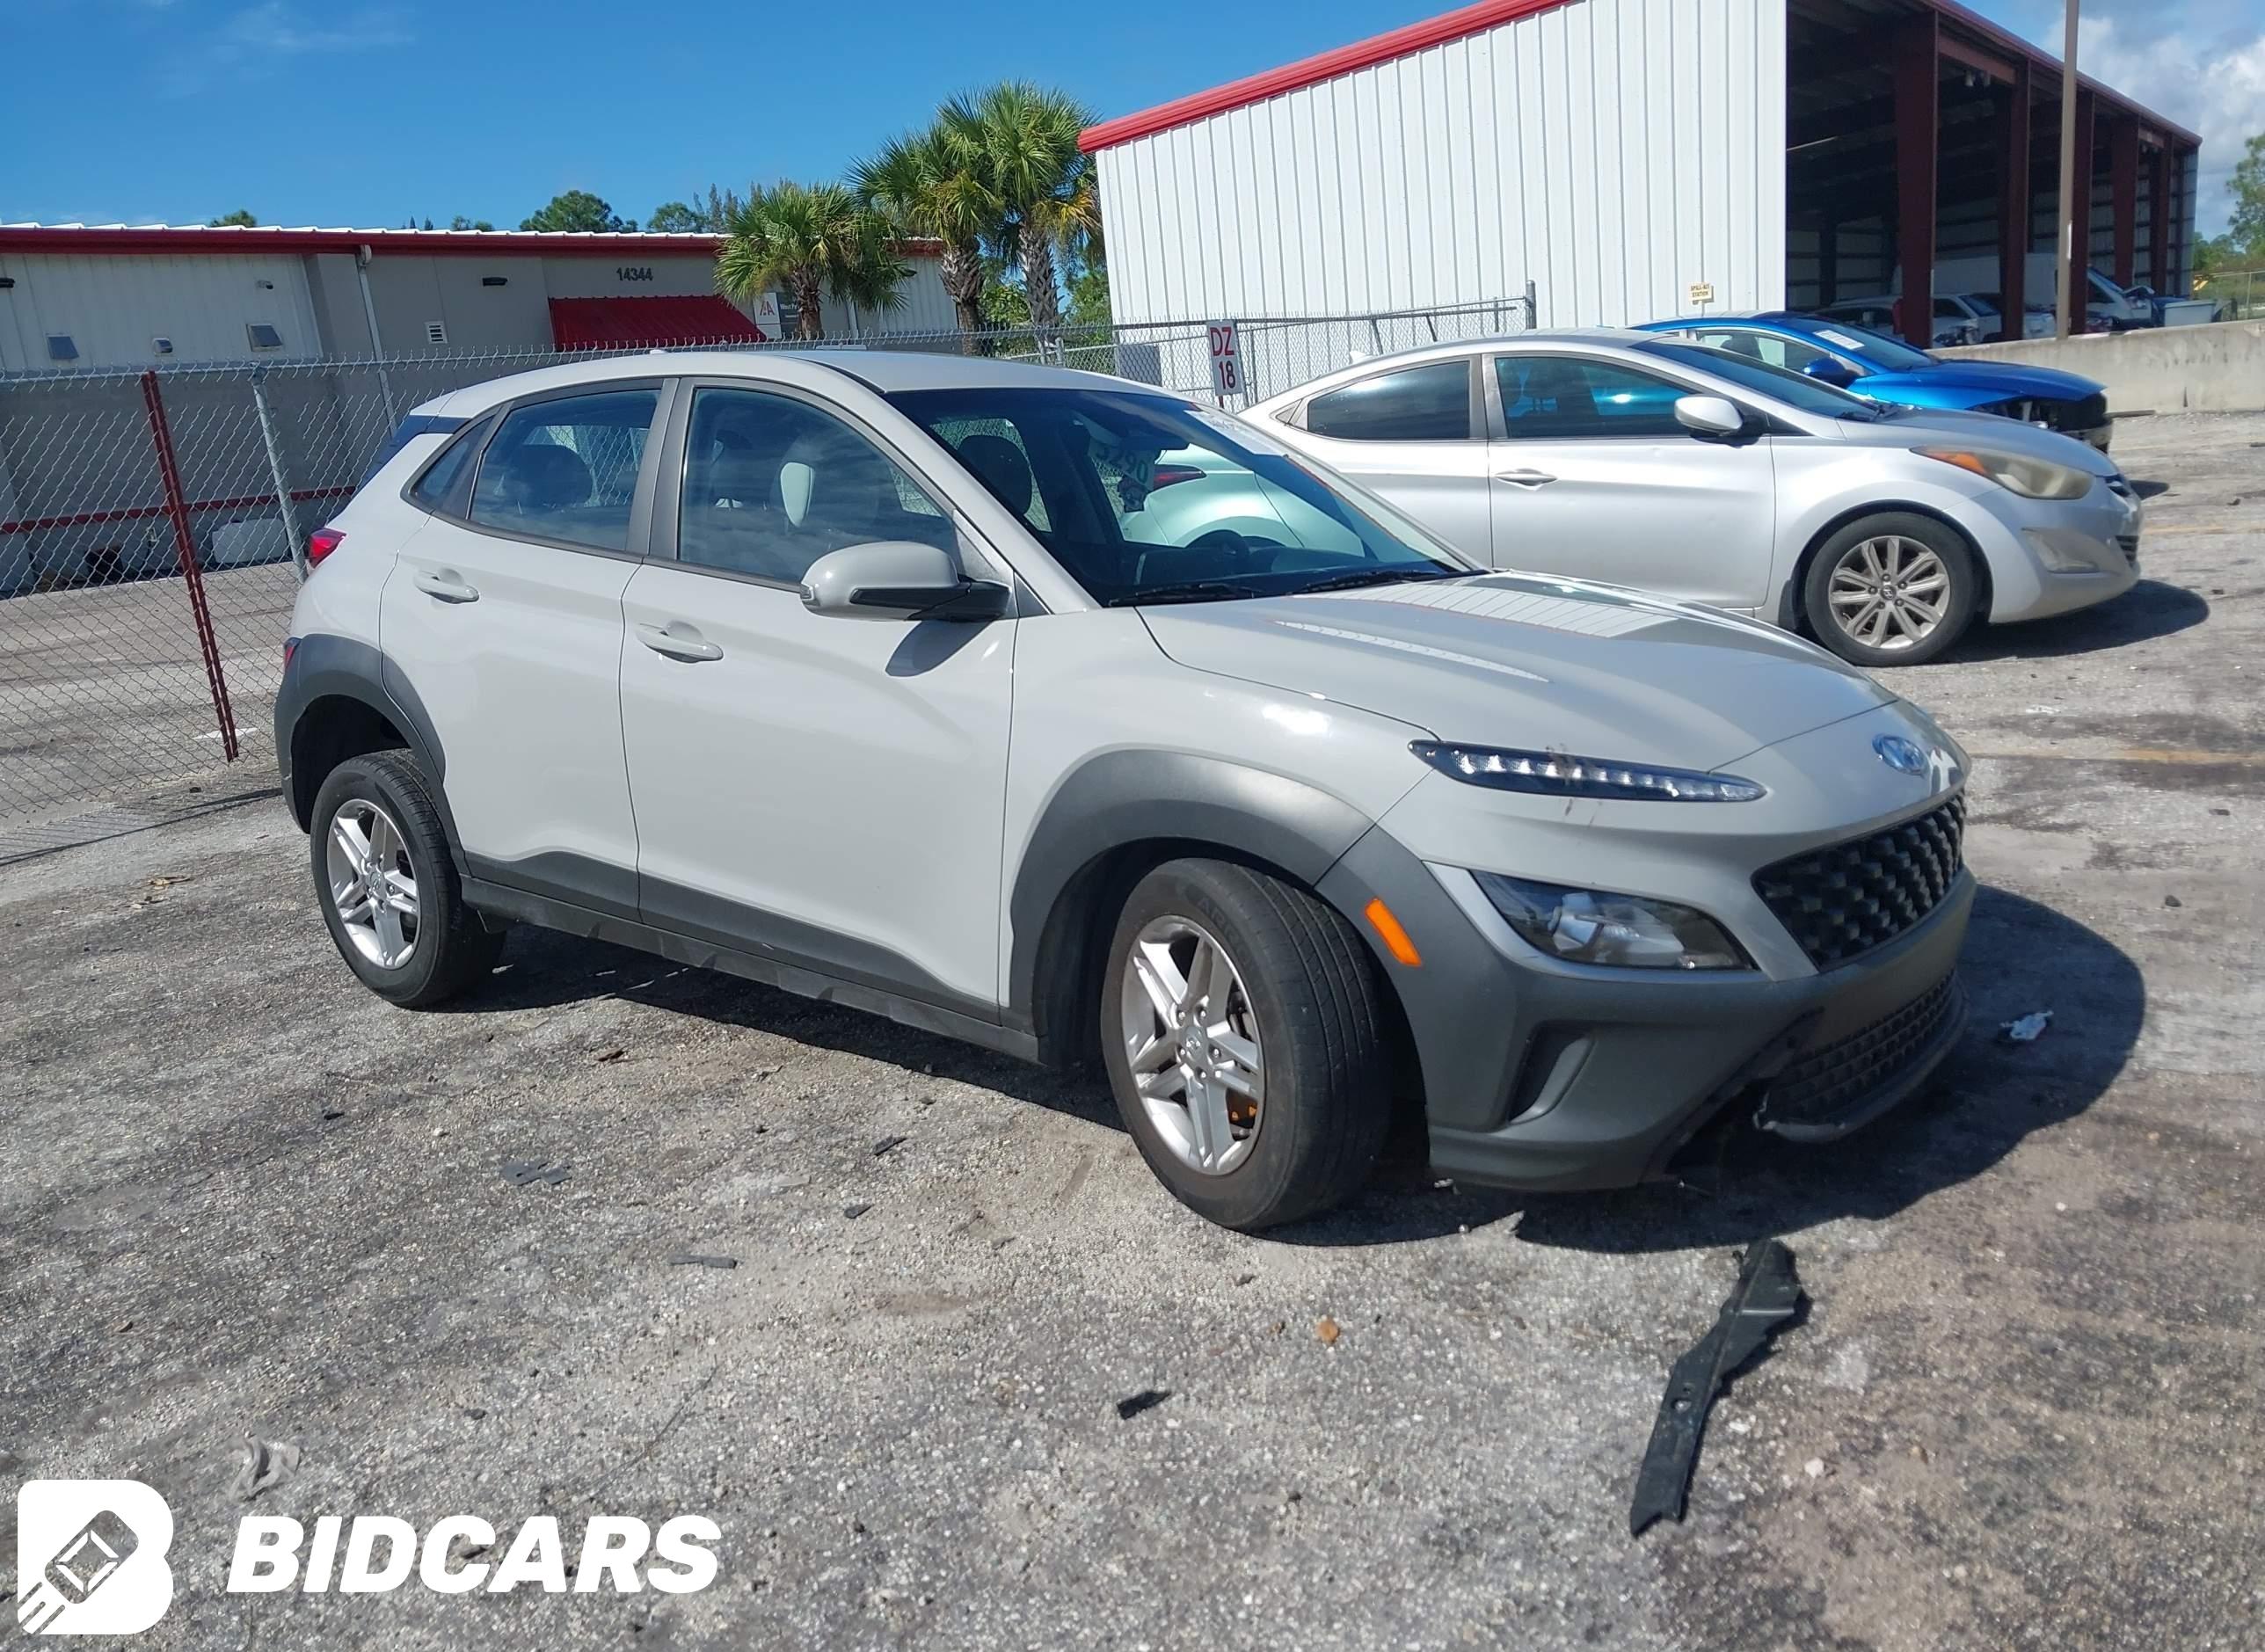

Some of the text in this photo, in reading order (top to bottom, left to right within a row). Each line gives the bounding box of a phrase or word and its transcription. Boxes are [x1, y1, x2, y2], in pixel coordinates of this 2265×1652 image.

[615, 266, 653, 281] 14344
[1209, 326, 1235, 357] DZ
[1218, 360, 1236, 389] 18
